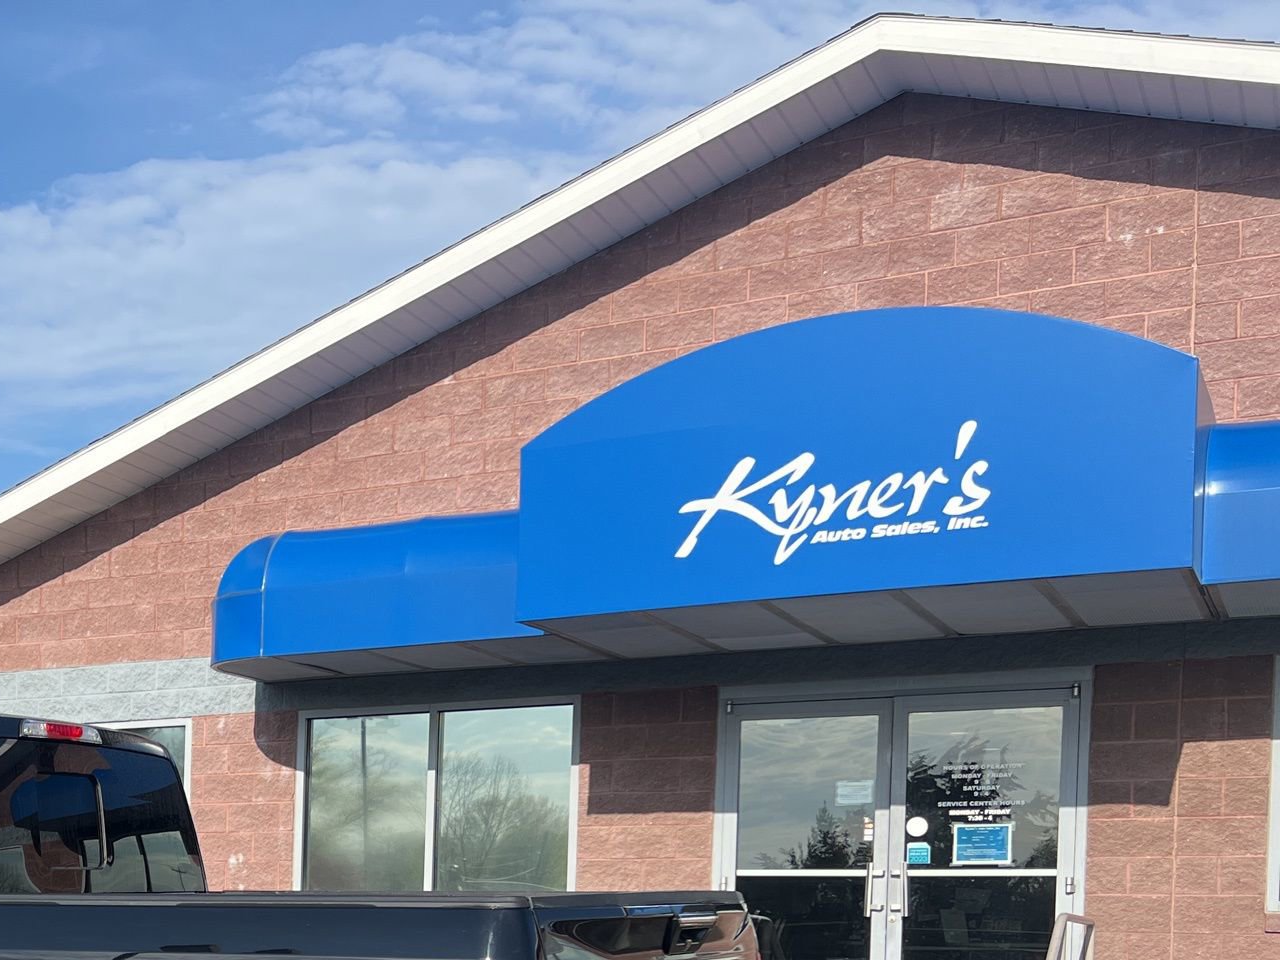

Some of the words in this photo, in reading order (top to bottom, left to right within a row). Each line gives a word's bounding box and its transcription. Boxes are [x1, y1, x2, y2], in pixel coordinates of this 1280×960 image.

[674, 420, 991, 565] Kyner's
[810, 526, 866, 544] Auto
[870, 519, 940, 538] Sales,
[947, 515, 989, 531] Inc.
